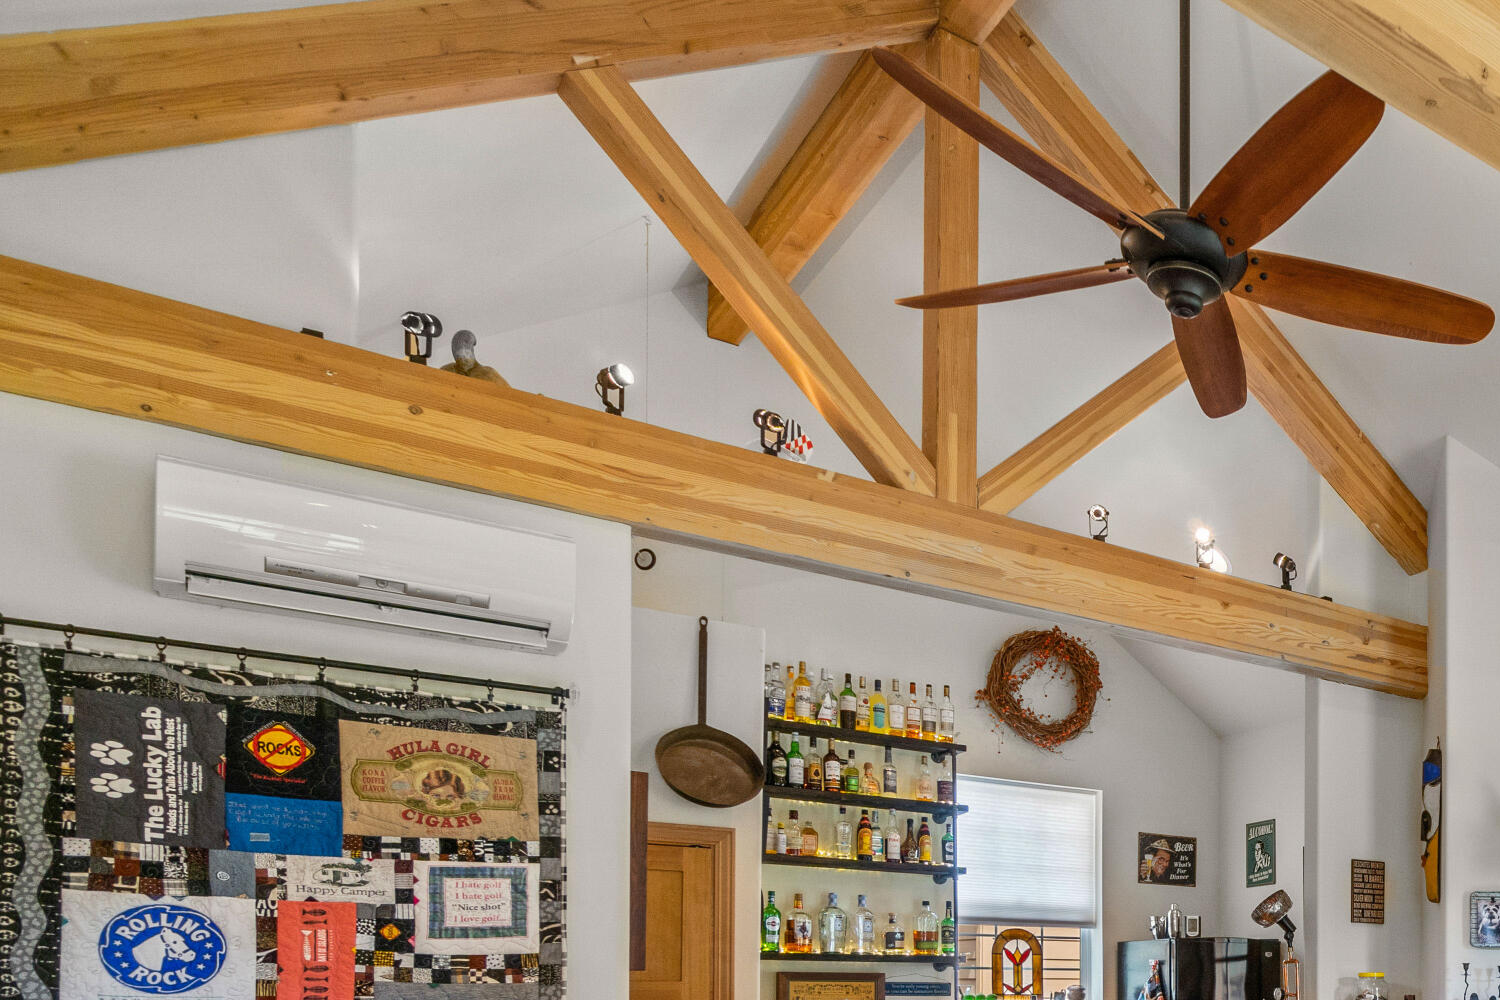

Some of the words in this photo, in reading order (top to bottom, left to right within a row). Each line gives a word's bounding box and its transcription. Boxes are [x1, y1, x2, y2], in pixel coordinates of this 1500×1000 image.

[140, 706, 162, 741] Lab
[164, 718, 175, 735] Rest
[165, 736, 175, 749] the
[256, 741, 302, 757] ROCKS
[165, 750, 175, 775] Above
[386, 740, 443, 760] HULA
[445, 742, 490, 769] GIRL
[142, 745, 167, 800] Lucky
[166, 794, 176, 808] and
[144, 805, 164, 842] The
[166, 809, 177, 834] Heads
[401, 809, 482, 828] CIGARS
[296, 884, 337, 896] Happy
[340, 887, 388, 898] Camper
[115, 913, 211, 942] ROLLING
[128, 966, 195, 985] ROCK
